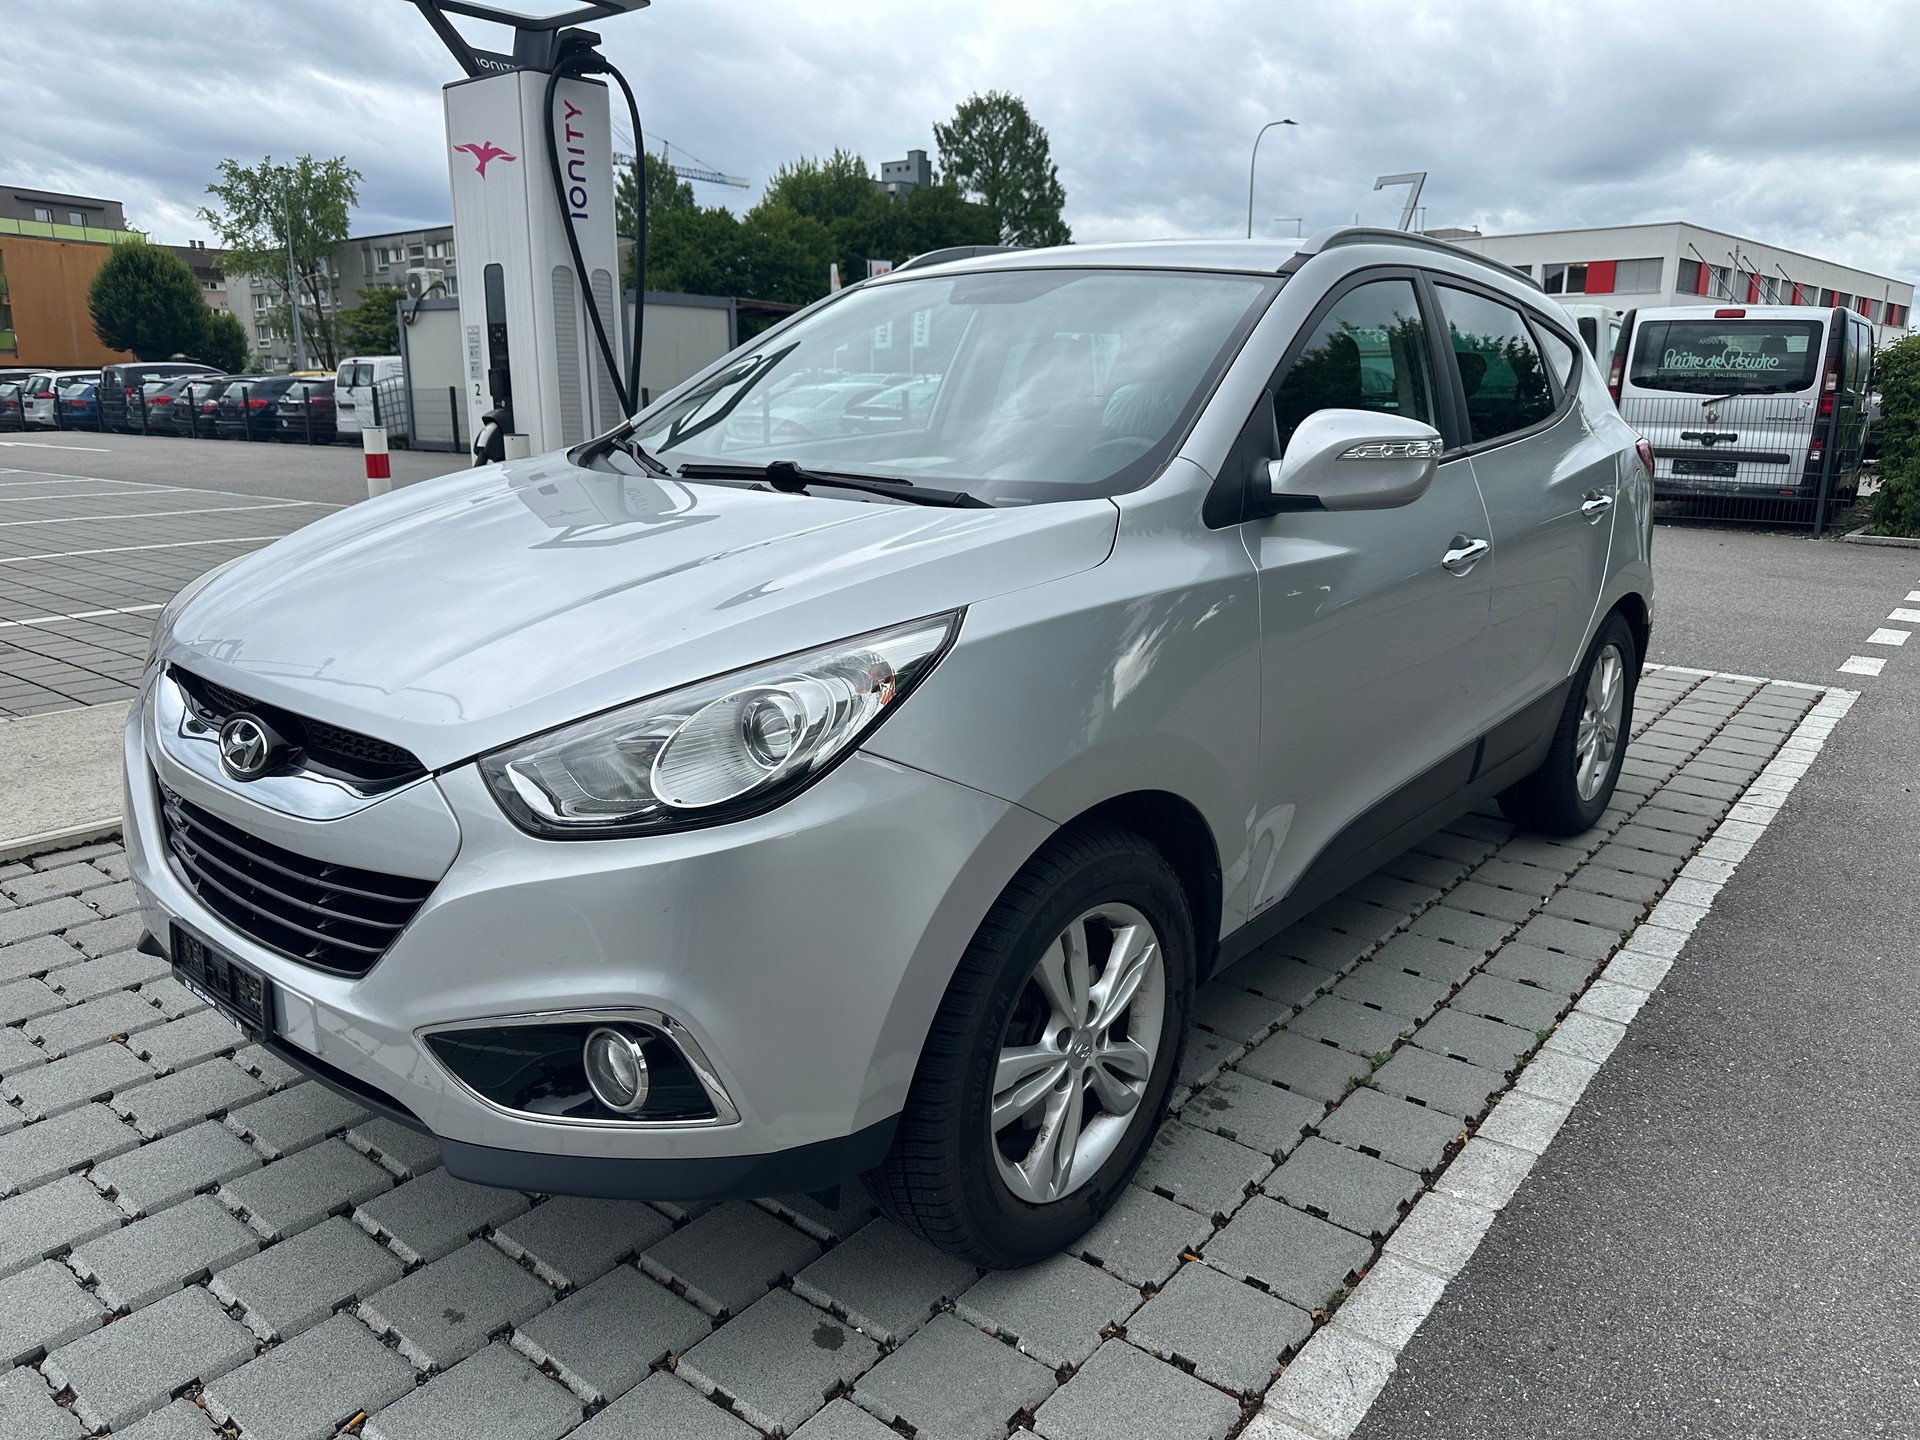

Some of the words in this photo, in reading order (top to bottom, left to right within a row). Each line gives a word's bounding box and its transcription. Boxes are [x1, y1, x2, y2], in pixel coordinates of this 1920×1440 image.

[475, 57, 515, 71] IONIT
[564, 99, 588, 219] IONITY
[475, 383, 481, 396] 2
[970, 1058, 988, 1125] 225/60
[983, 1015, 999, 1050] R17
